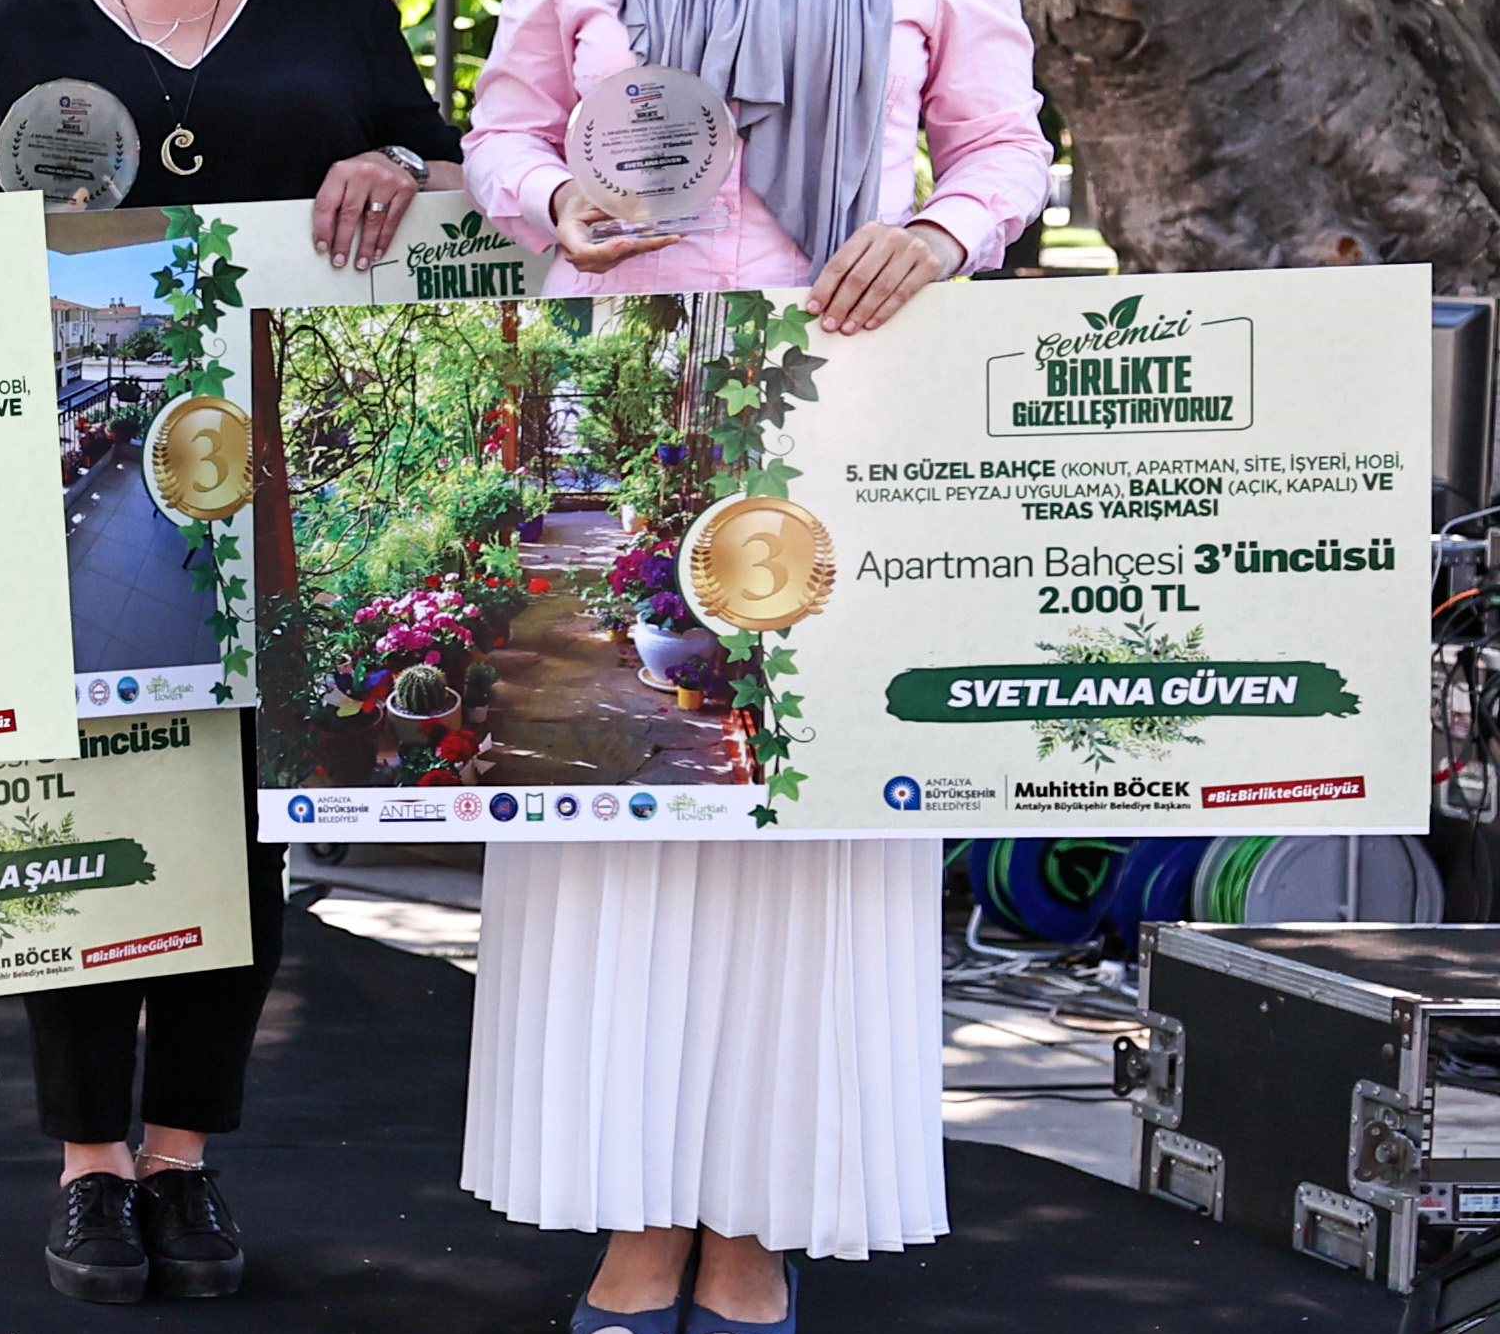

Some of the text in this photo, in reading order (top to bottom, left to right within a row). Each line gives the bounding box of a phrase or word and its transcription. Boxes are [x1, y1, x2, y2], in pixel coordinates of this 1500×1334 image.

[1035, 309, 1192, 370] Çevremizi
[857, 551, 1033, 587] Apartman
[1046, 545, 1182, 584] Bahçesi
[1039, 585, 1199, 614] 2.000 TL
[947, 667, 1298, 708] SVETLANA GÜVEN
[36, 773, 75, 800] TL
[1015, 777, 1189, 797] Muhittin BÖCEK
[1208, 782, 1359, 802] #BizBirlikteGüçlüyüz
[380, 804, 446, 821] ANTEPE
[24, 852, 106, 893] ŞALLI
[15, 947, 72, 966] BÖCEK
[86, 933, 197, 963] #BizBirlikteGüçlüyüz
